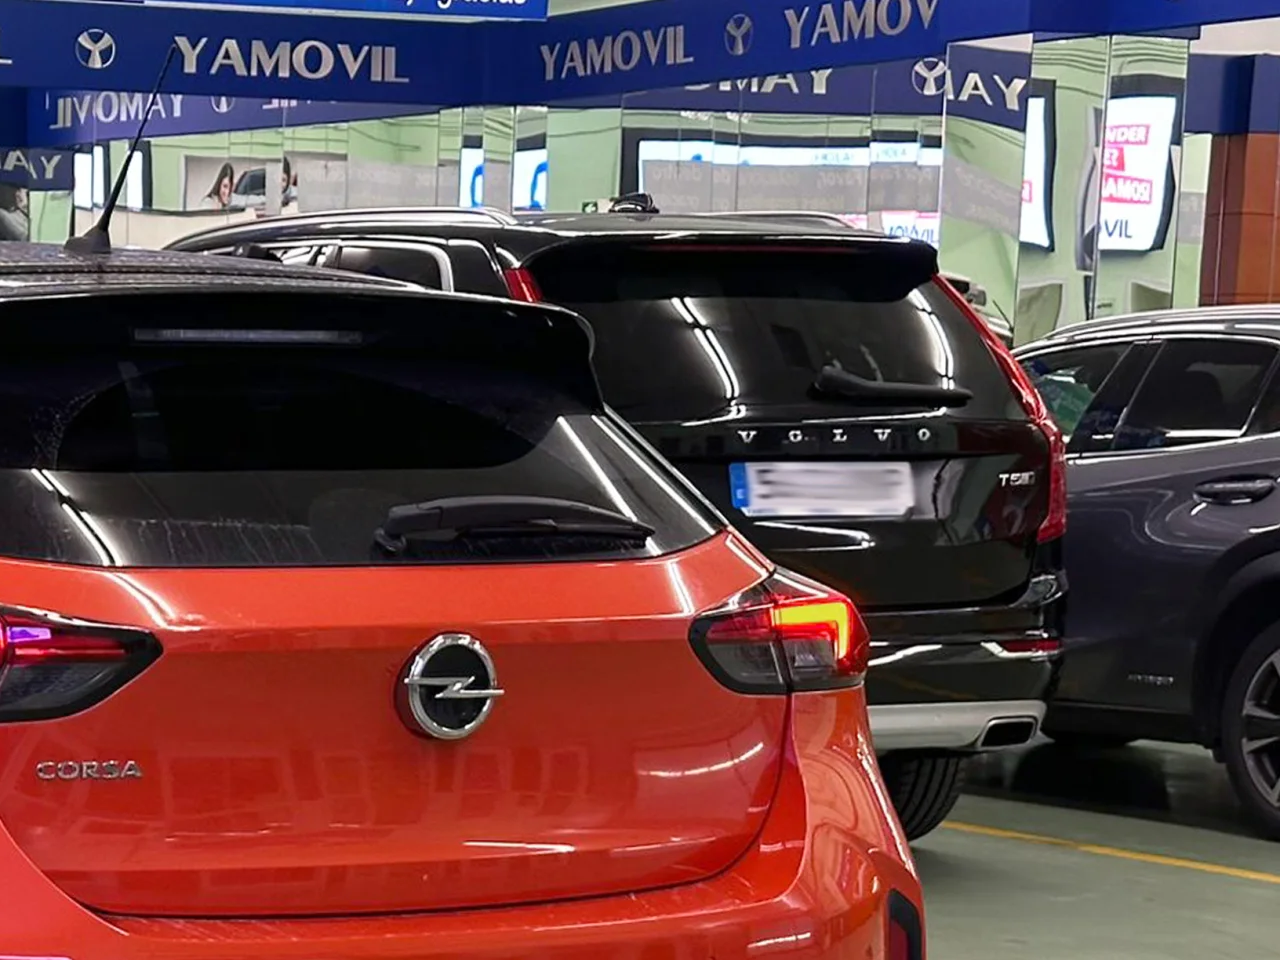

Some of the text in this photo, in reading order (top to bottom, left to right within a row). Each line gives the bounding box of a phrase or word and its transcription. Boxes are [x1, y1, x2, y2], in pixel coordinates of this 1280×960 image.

[174, 36, 410, 83] YAMOVIL
[540, 25, 693, 80] YAMOVIL
[737, 428, 932, 443] VOLVO
[36, 760, 143, 780] CORSA
